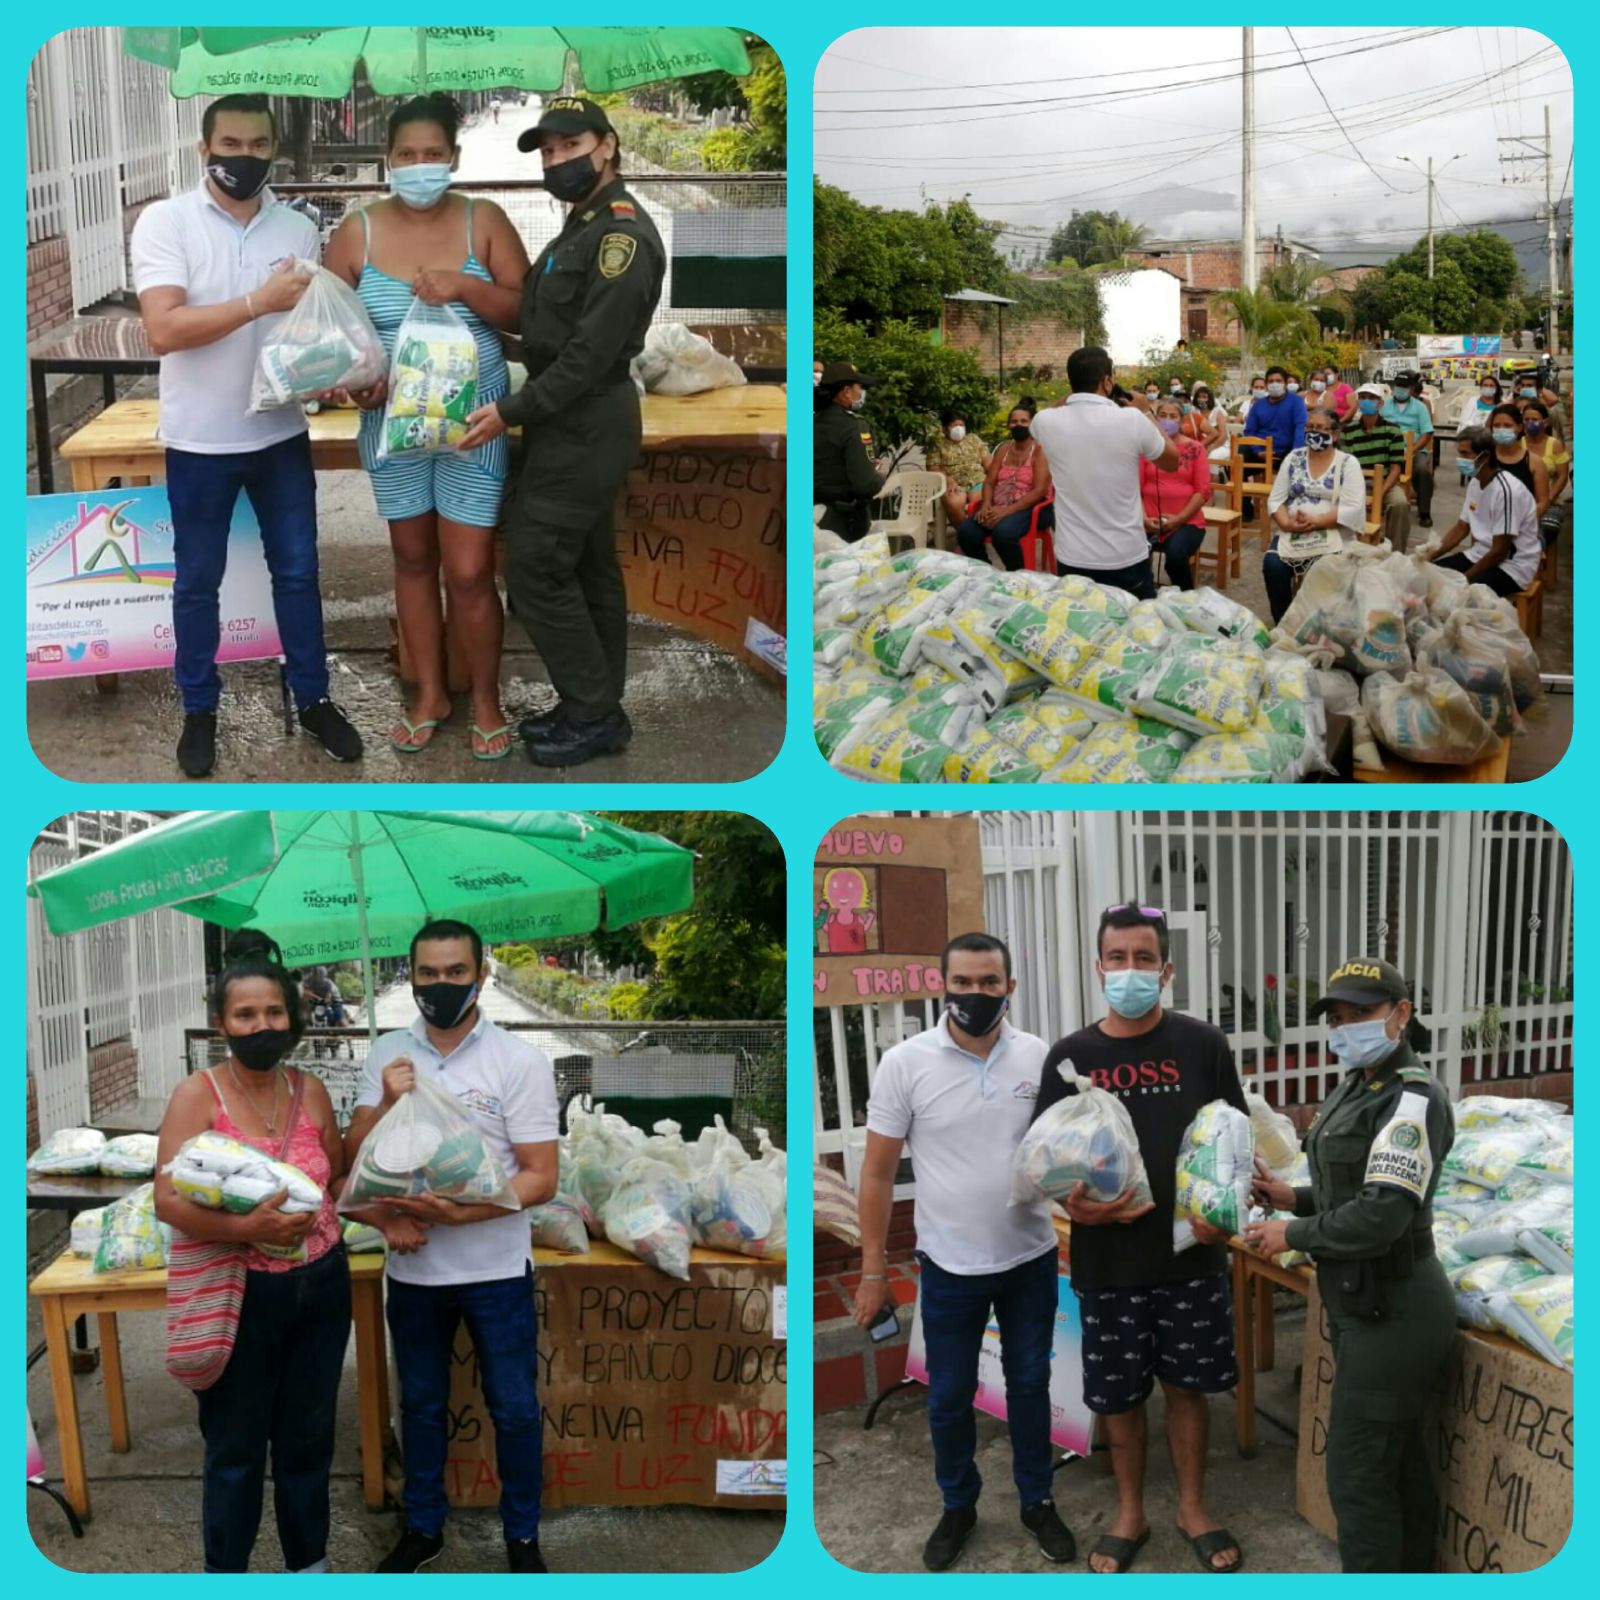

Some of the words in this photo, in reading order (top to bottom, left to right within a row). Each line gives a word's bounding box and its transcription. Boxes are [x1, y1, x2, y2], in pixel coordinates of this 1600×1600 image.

[625, 492, 743, 531] BANCO
[652, 570, 737, 632] LUZ
[227, 616, 257, 632] 6257
[852, 963, 945, 996] TRATO
[1088, 1058, 1181, 1090] BOSS
[578, 1285, 769, 1335] PROYECTO
[582, 1342, 693, 1384] BANCO
[541, 1403, 645, 1443] NEIVA
[614, 1452, 704, 1492] LUZ
[1485, 1455, 1548, 1549] MIL
